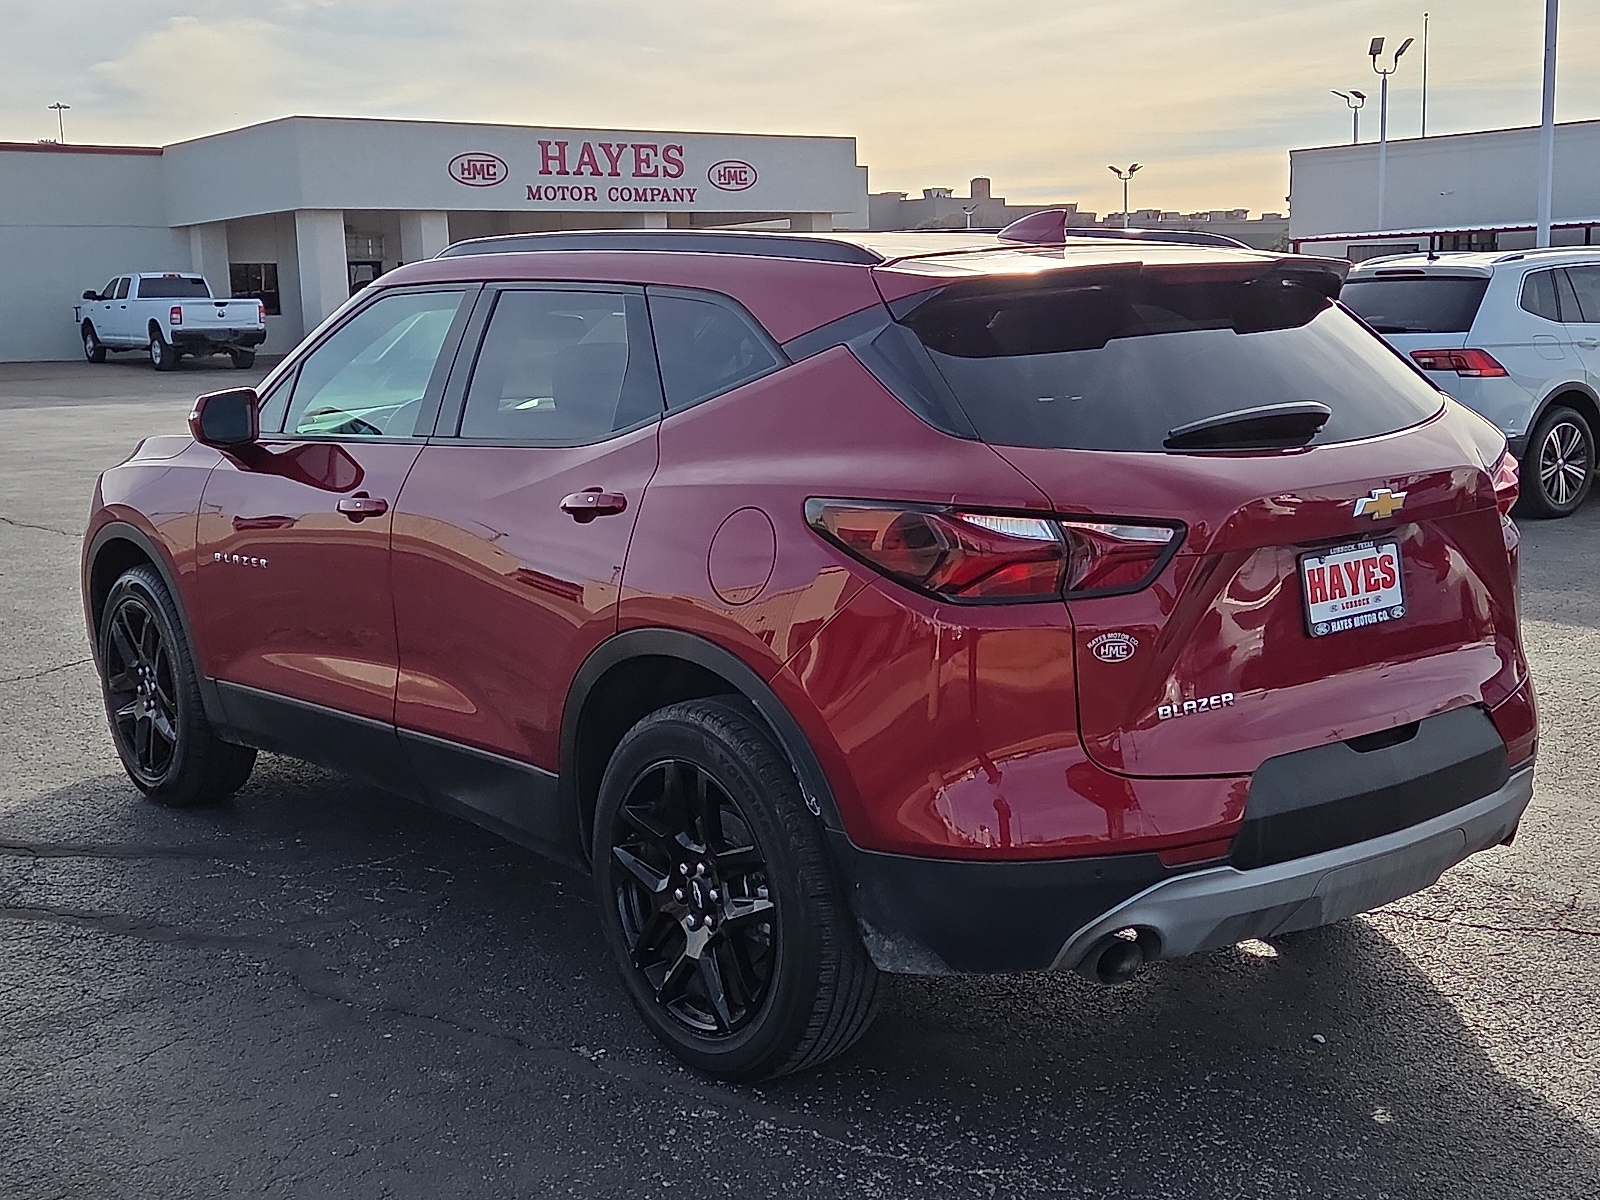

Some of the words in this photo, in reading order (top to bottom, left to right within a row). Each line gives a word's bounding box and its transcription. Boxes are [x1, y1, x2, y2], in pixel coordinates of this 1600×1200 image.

[537, 140, 685, 178] HAYES
[460, 158, 497, 180] HMC
[717, 165, 748, 185] HMC
[526, 185, 598, 202] MOTOR
[608, 187, 697, 203] COMPANY
[1357, 541, 1374, 550] TEXAS
[214, 552, 268, 569] BLAZER
[1307, 554, 1397, 605] HAYES
[1341, 598, 1371, 611] LUBBOCK
[1331, 618, 1353, 632] HAYES
[1354, 613, 1378, 628] MOTOR
[1378, 610, 1390, 622] CO.
[1087, 633, 1106, 649] HAYES
[1107, 632, 1130, 641] MOTOR
[1130, 635, 1140, 648] CO.
[1100, 643, 1128, 658] HMC
[1158, 692, 1235, 720] BLAZER
